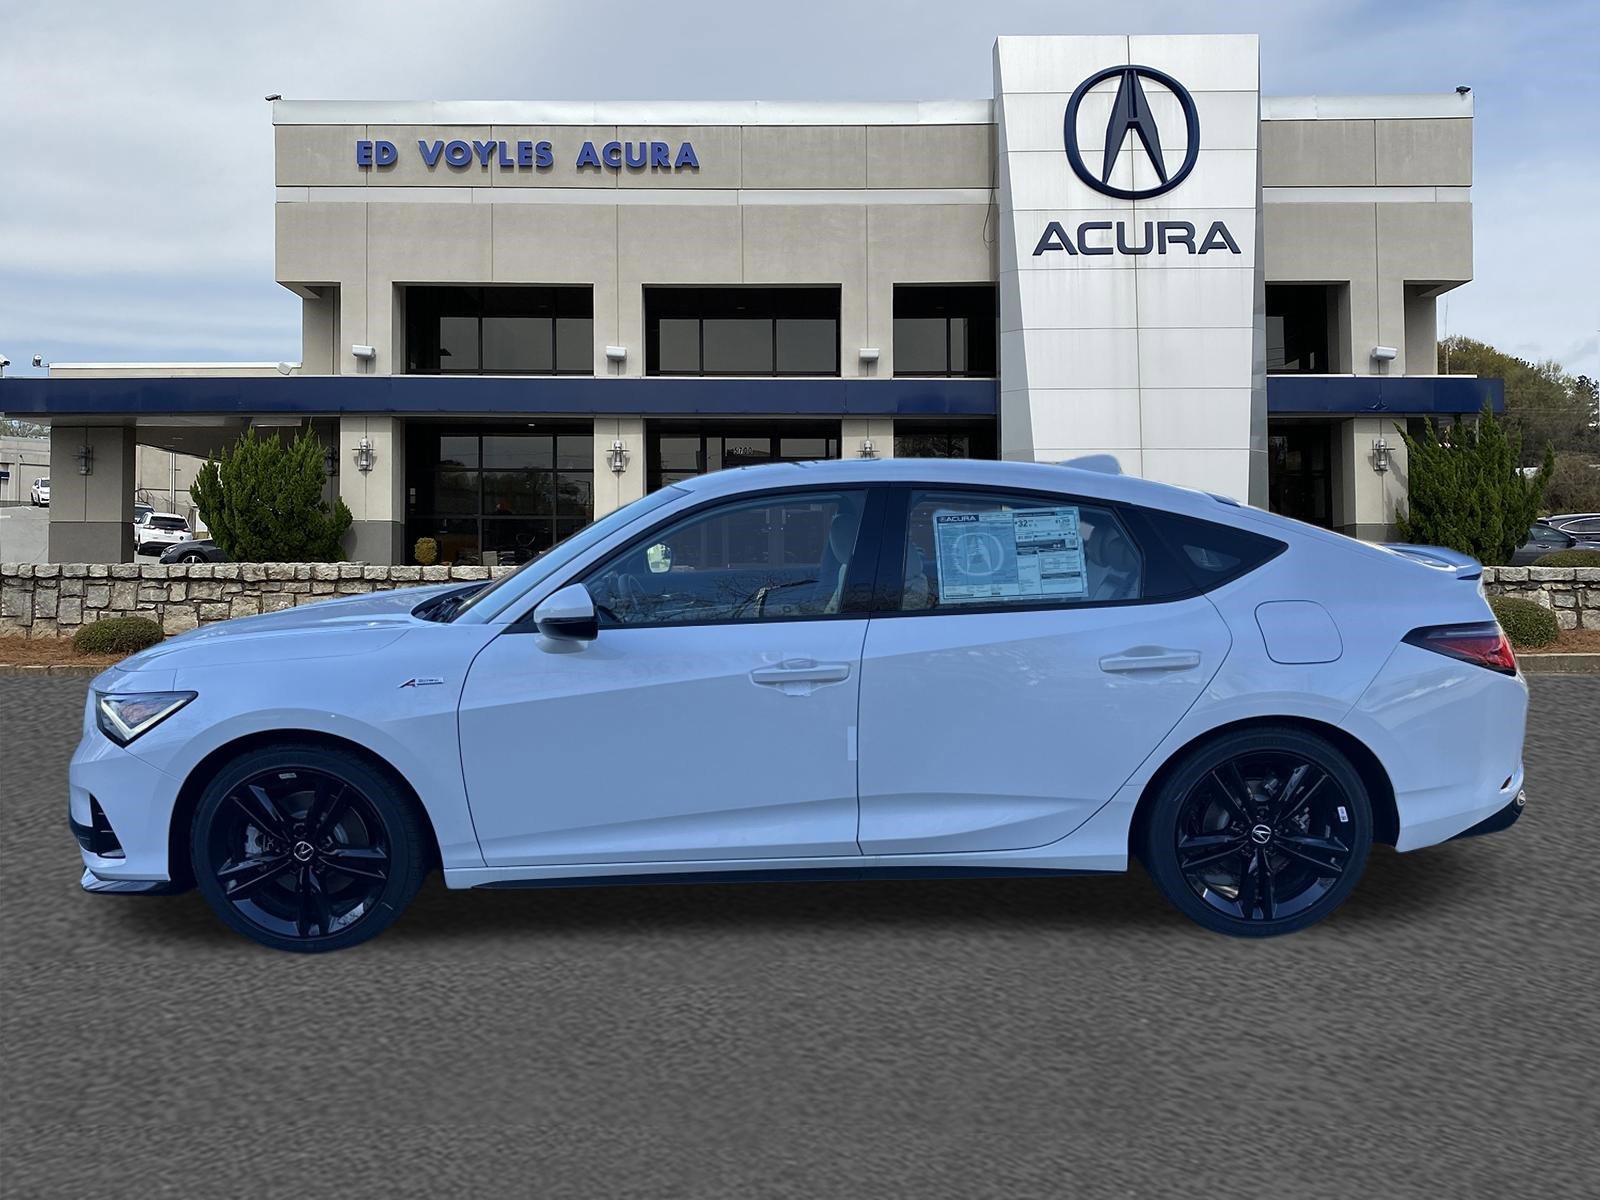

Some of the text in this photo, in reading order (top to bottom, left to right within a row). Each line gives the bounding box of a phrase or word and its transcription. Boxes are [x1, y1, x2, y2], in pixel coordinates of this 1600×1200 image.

[356, 140, 700, 169] ED VOYLES ACURA
[1032, 221, 1242, 256] ACURA
